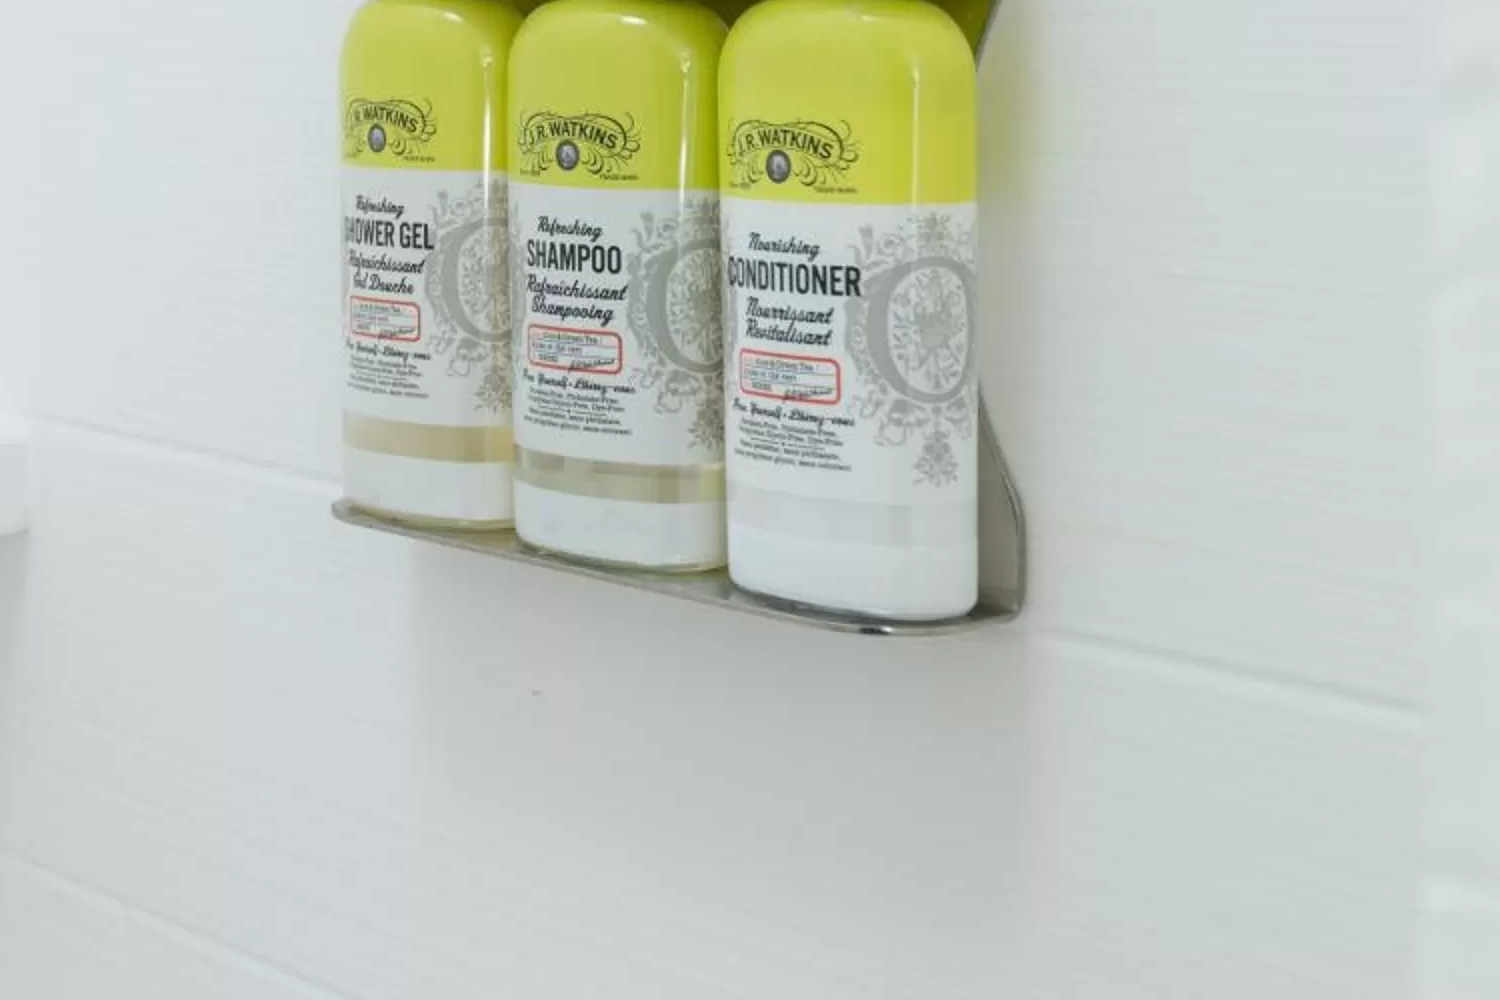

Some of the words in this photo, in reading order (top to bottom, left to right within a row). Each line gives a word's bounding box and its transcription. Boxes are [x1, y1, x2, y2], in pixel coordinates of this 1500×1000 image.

[364, 106, 418, 133] WATKINS
[549, 120, 618, 149] WATKINS
[757, 129, 834, 159] WATKINS
[399, 221, 435, 250] GEL
[537, 215, 603, 242] Refreshing
[526, 238, 622, 275] SHAMPOO
[748, 231, 821, 262] Nourishing
[368, 273, 415, 295] Douche
[727, 255, 862, 297] CONDITIONER
[531, 294, 614, 327] Shampooing
[745, 296, 835, 324] Nourrissant
[745, 318, 834, 346] Revitalisant
